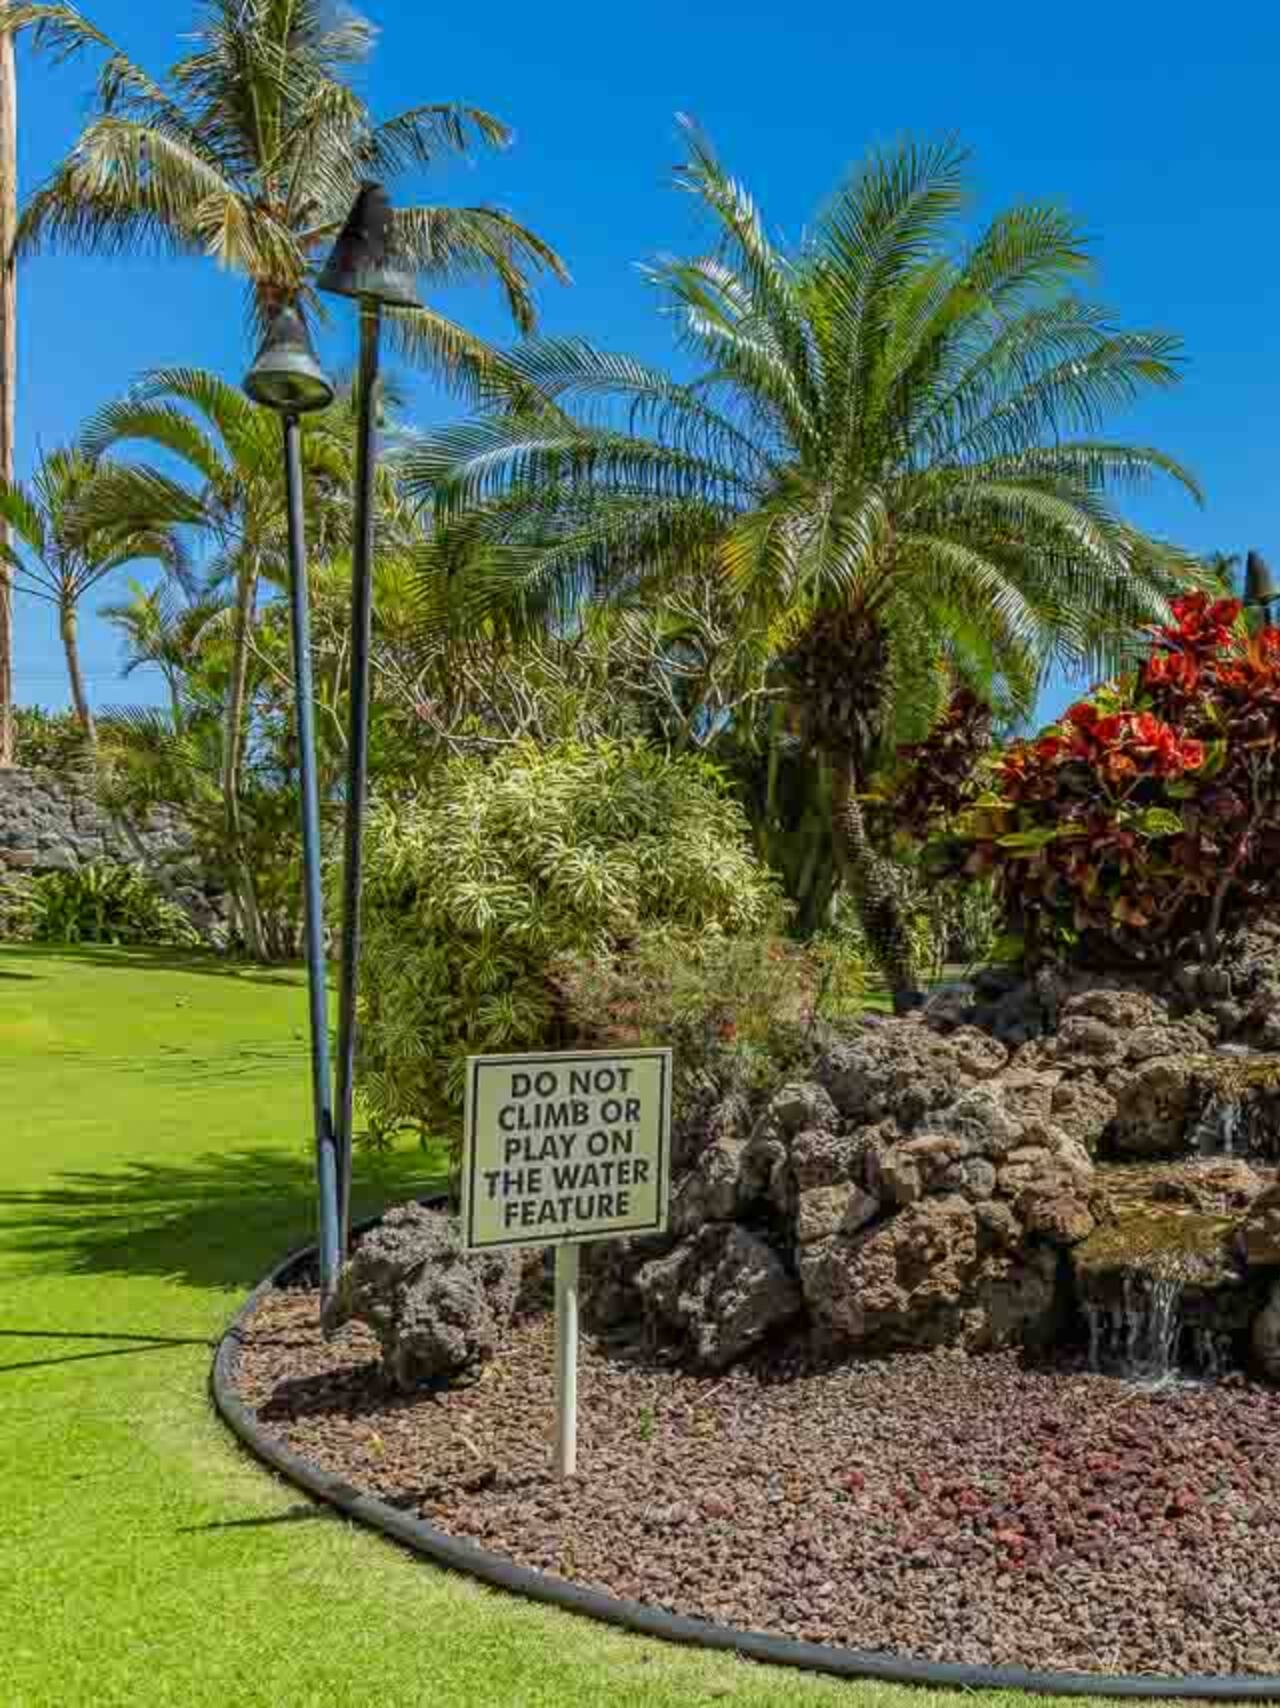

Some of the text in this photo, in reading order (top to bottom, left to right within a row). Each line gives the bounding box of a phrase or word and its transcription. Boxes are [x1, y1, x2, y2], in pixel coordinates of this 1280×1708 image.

[512, 1068, 632, 1097] DO NOT
[498, 1098, 640, 1131] CLIMB OR
[505, 1129, 632, 1164] PLAY ON
[483, 1159, 649, 1199] THE WATER
[504, 1192, 629, 1228] FEATURE
